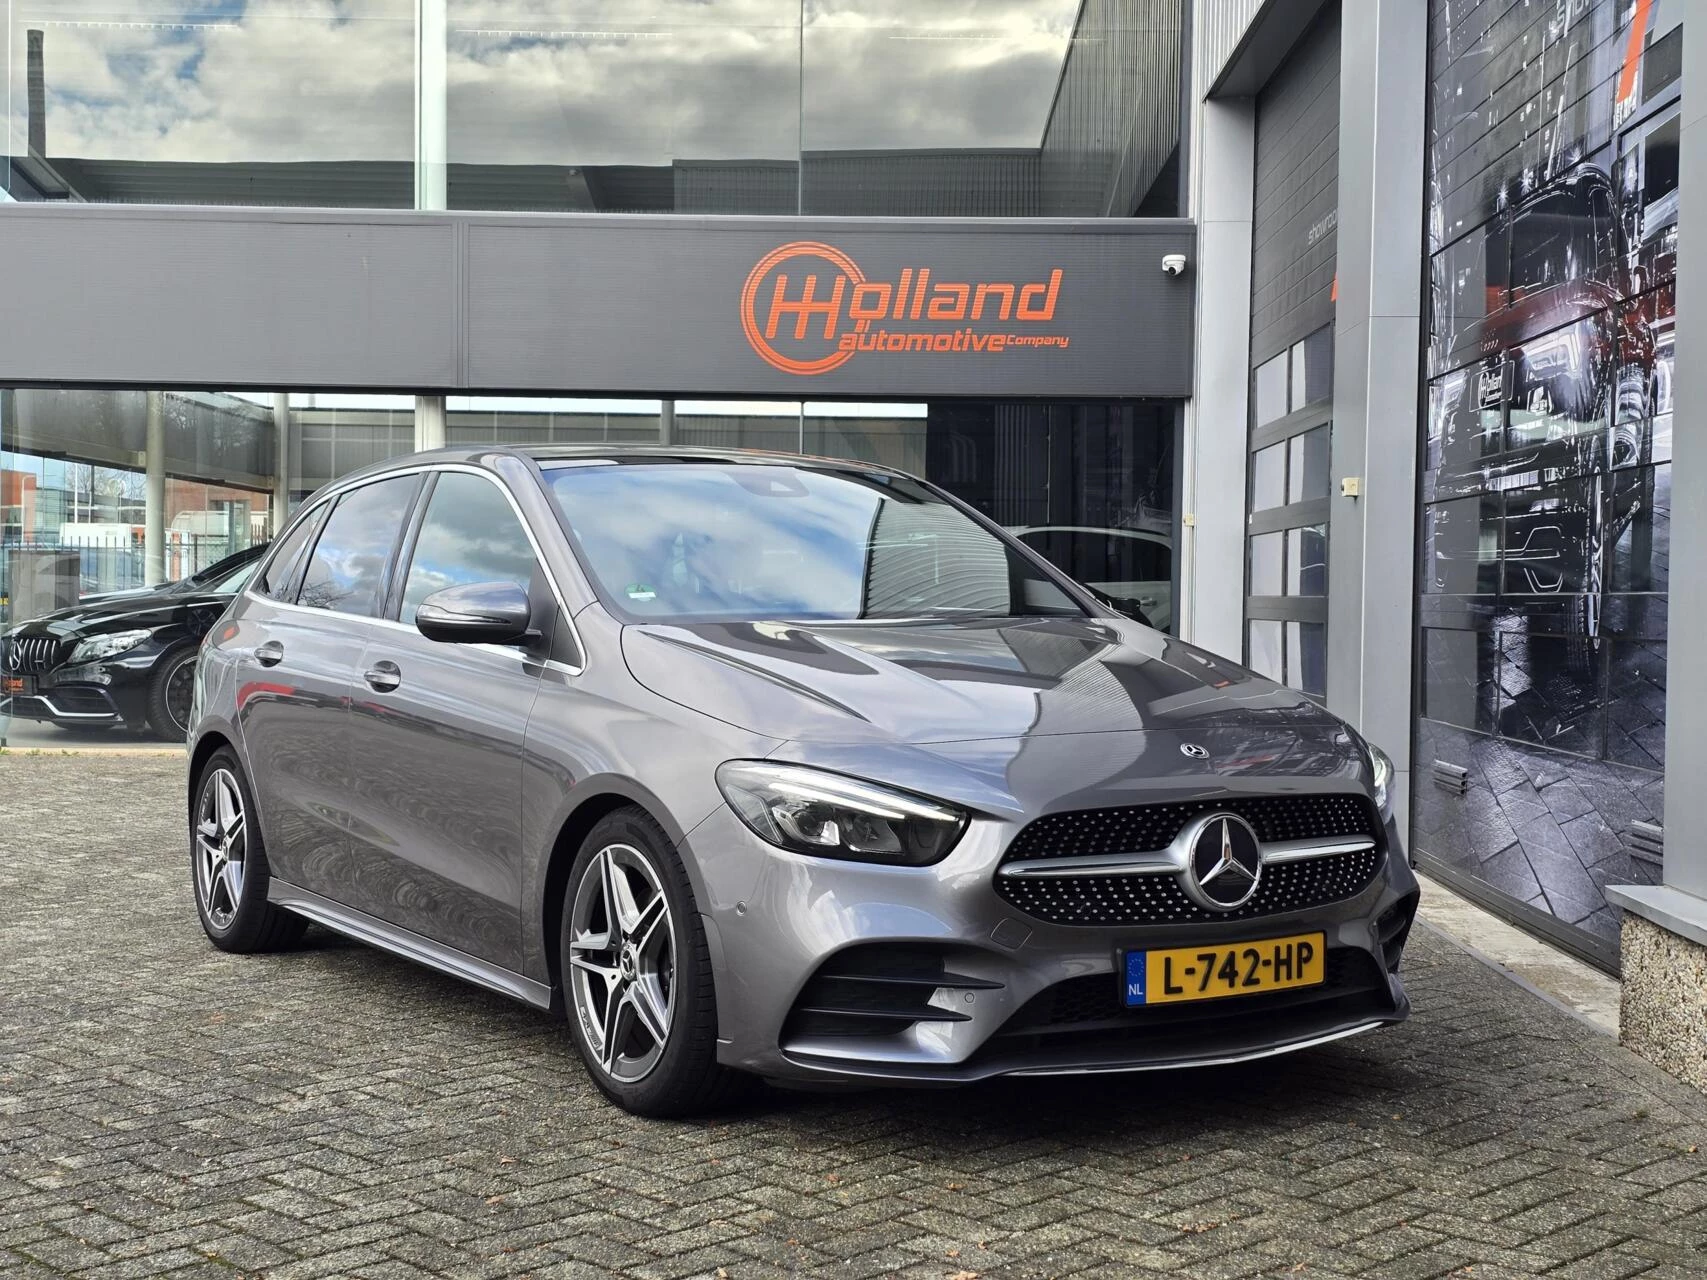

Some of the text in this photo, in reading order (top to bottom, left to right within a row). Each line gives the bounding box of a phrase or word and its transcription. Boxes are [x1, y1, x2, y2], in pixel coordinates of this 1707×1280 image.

[1308, 209, 1337, 245] showroo
[838, 328, 1070, 352] automotive Company
[1163, 941, 1314, 996] L-742-HP
[1128, 983, 1144, 996] NL
